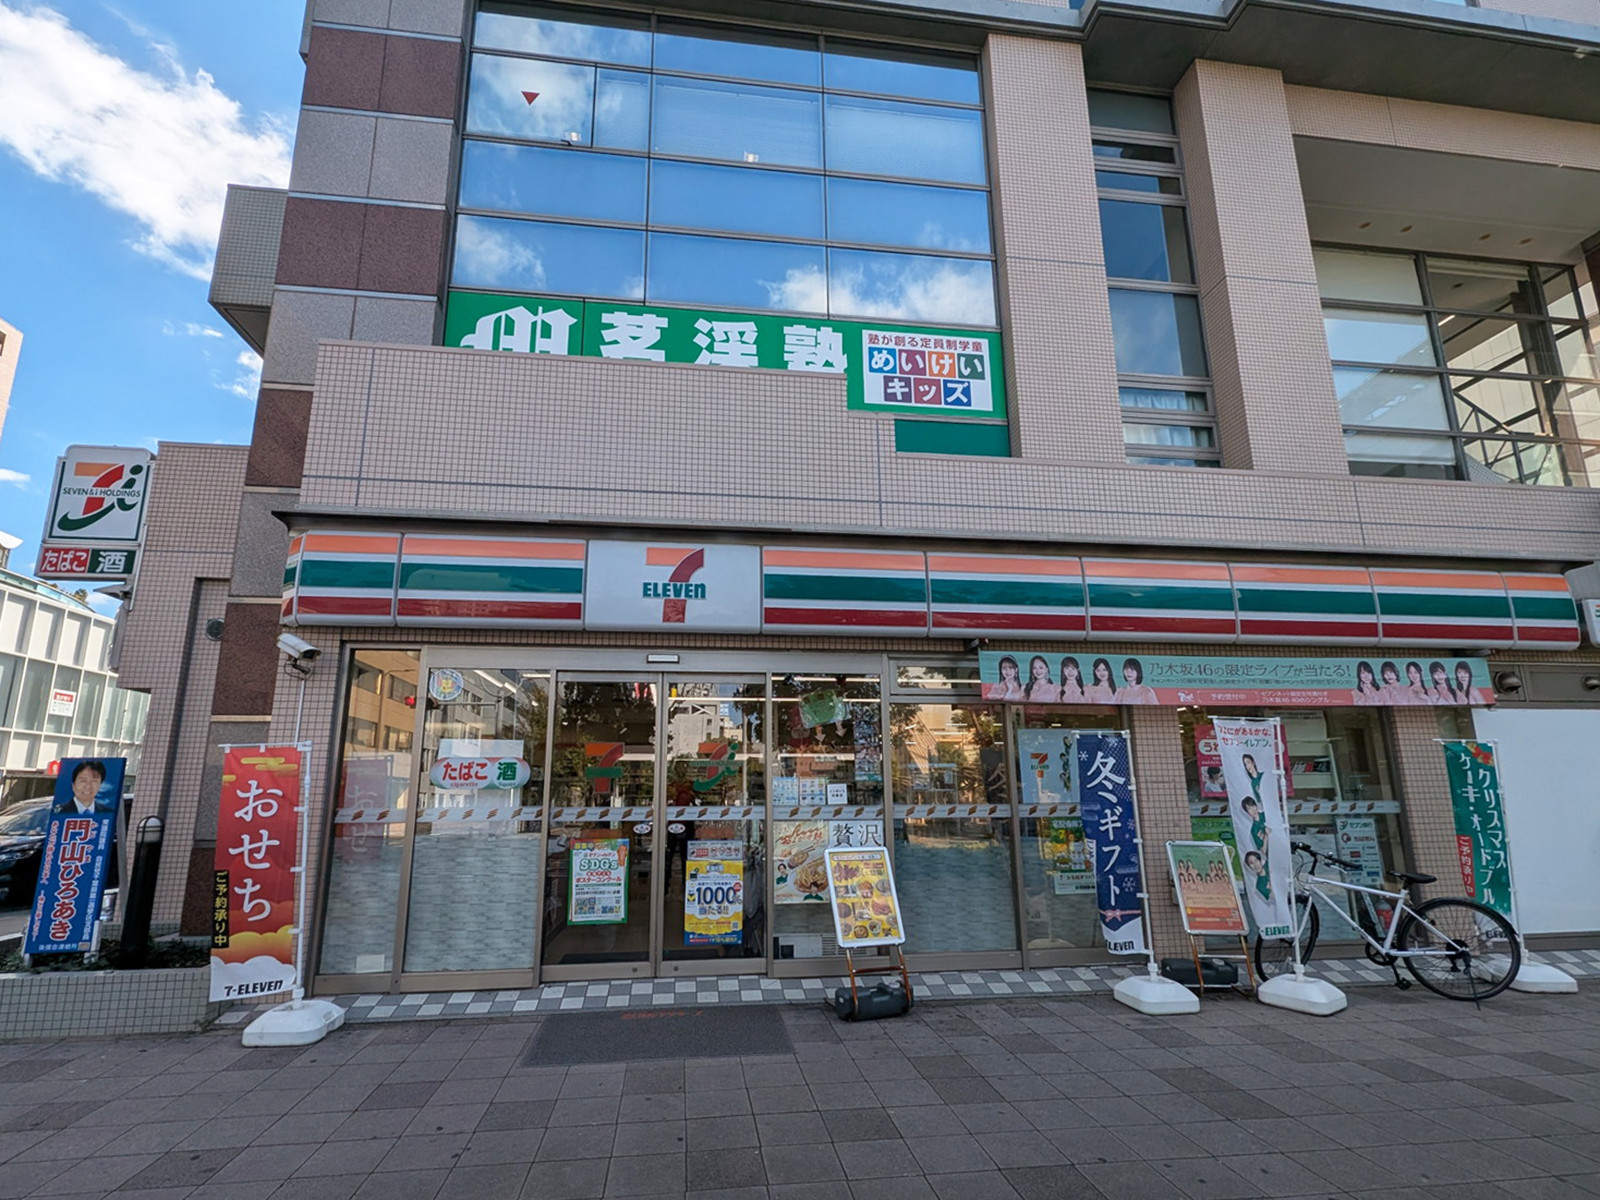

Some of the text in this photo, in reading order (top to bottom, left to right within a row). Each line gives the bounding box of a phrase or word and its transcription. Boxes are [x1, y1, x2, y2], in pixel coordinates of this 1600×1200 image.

[867, 333, 984, 353] 塾が創る定員制学童
[871, 349, 983, 376] めいけい
[886, 377, 969, 404] キッズ
[100, 488, 141, 498] HOLDINGS
[41, 549, 128, 573] たばこ 酒
[442, 761, 518, 781] たばこ 酒
[1086, 751, 1127, 906] 冬ギフト
[1478, 768, 1507, 870] クリスマス
[833, 823, 882, 847] 贅沢
[228, 780, 283, 922] おせち
[580, 858, 619, 871] SDGs
[49, 818, 94, 941] 門山ひろあき
[213, 871, 228, 947] ご予約承り中
